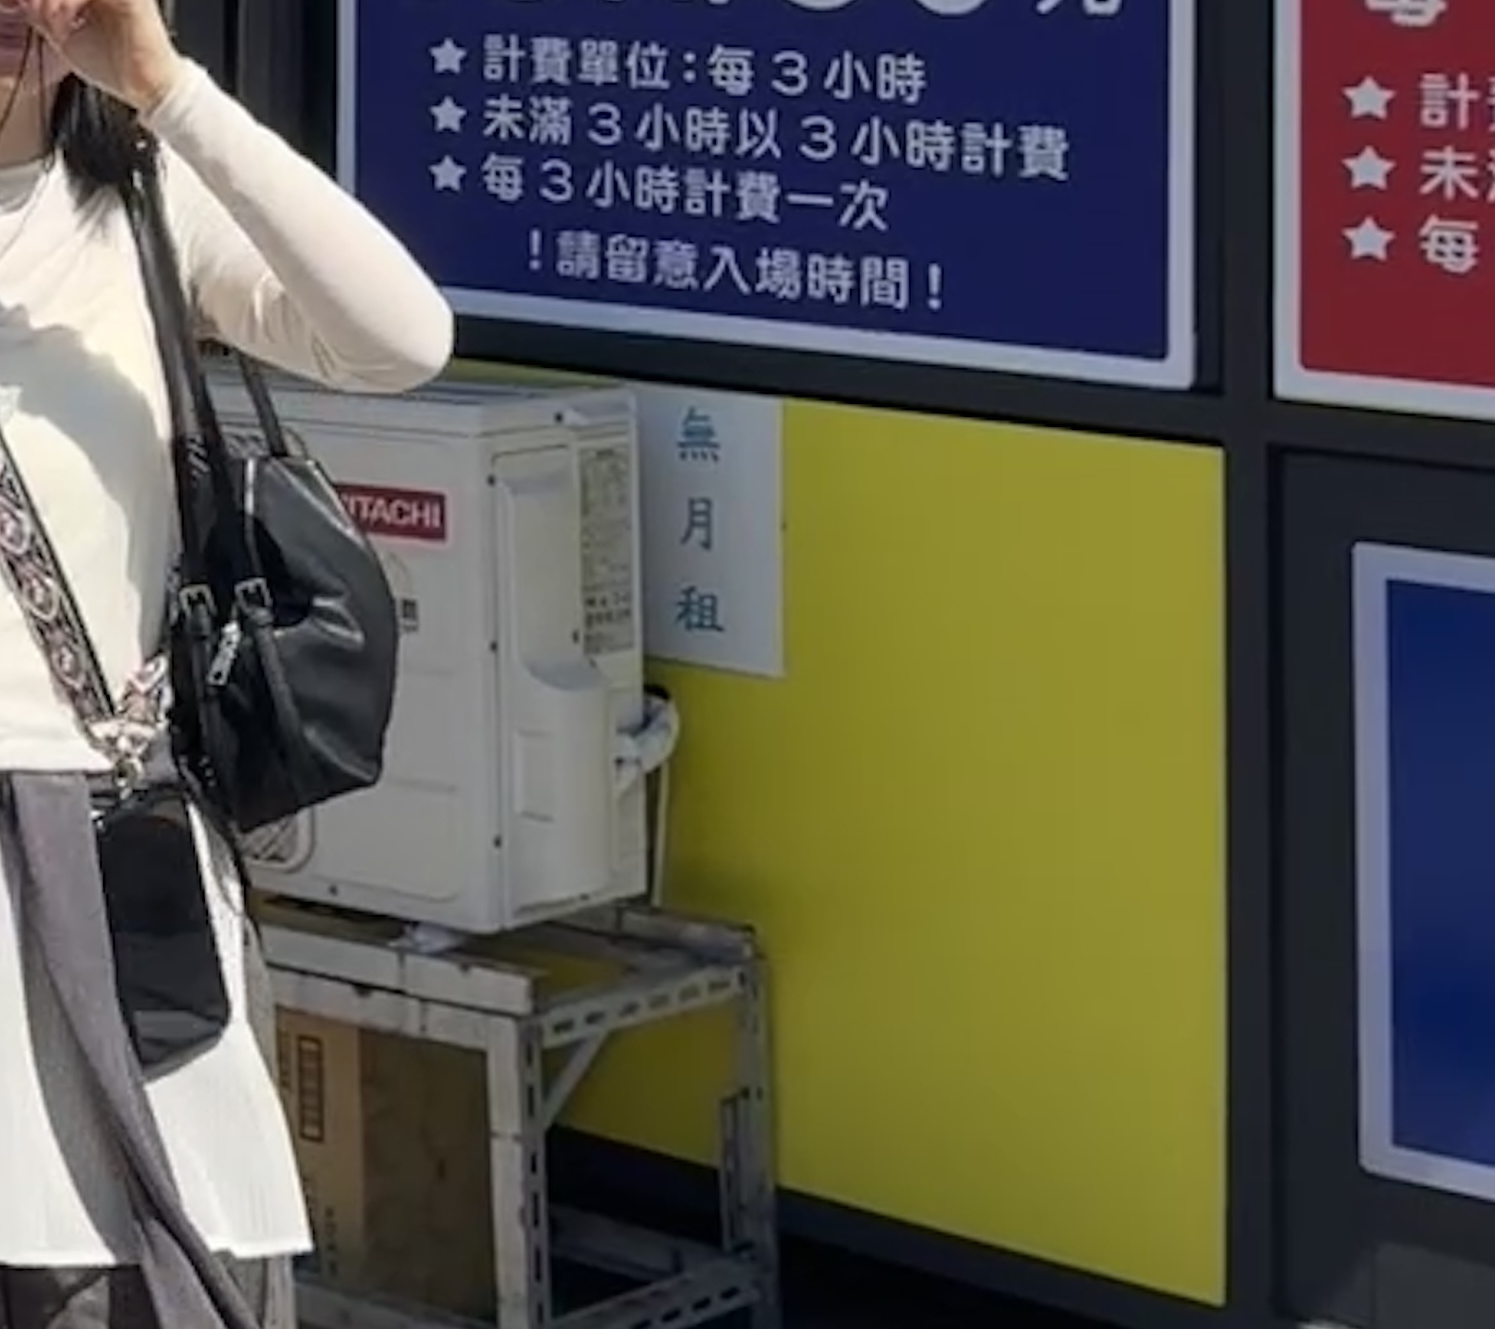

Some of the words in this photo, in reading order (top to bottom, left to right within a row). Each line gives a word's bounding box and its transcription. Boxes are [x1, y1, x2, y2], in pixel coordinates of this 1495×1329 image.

[1419, 72, 1495, 131] 計
[1419, 146, 1495, 202] 未
[1418, 213, 1479, 274] 每
[341, 493, 442, 529] ITACHI
[674, 407, 726, 634] 無月租
